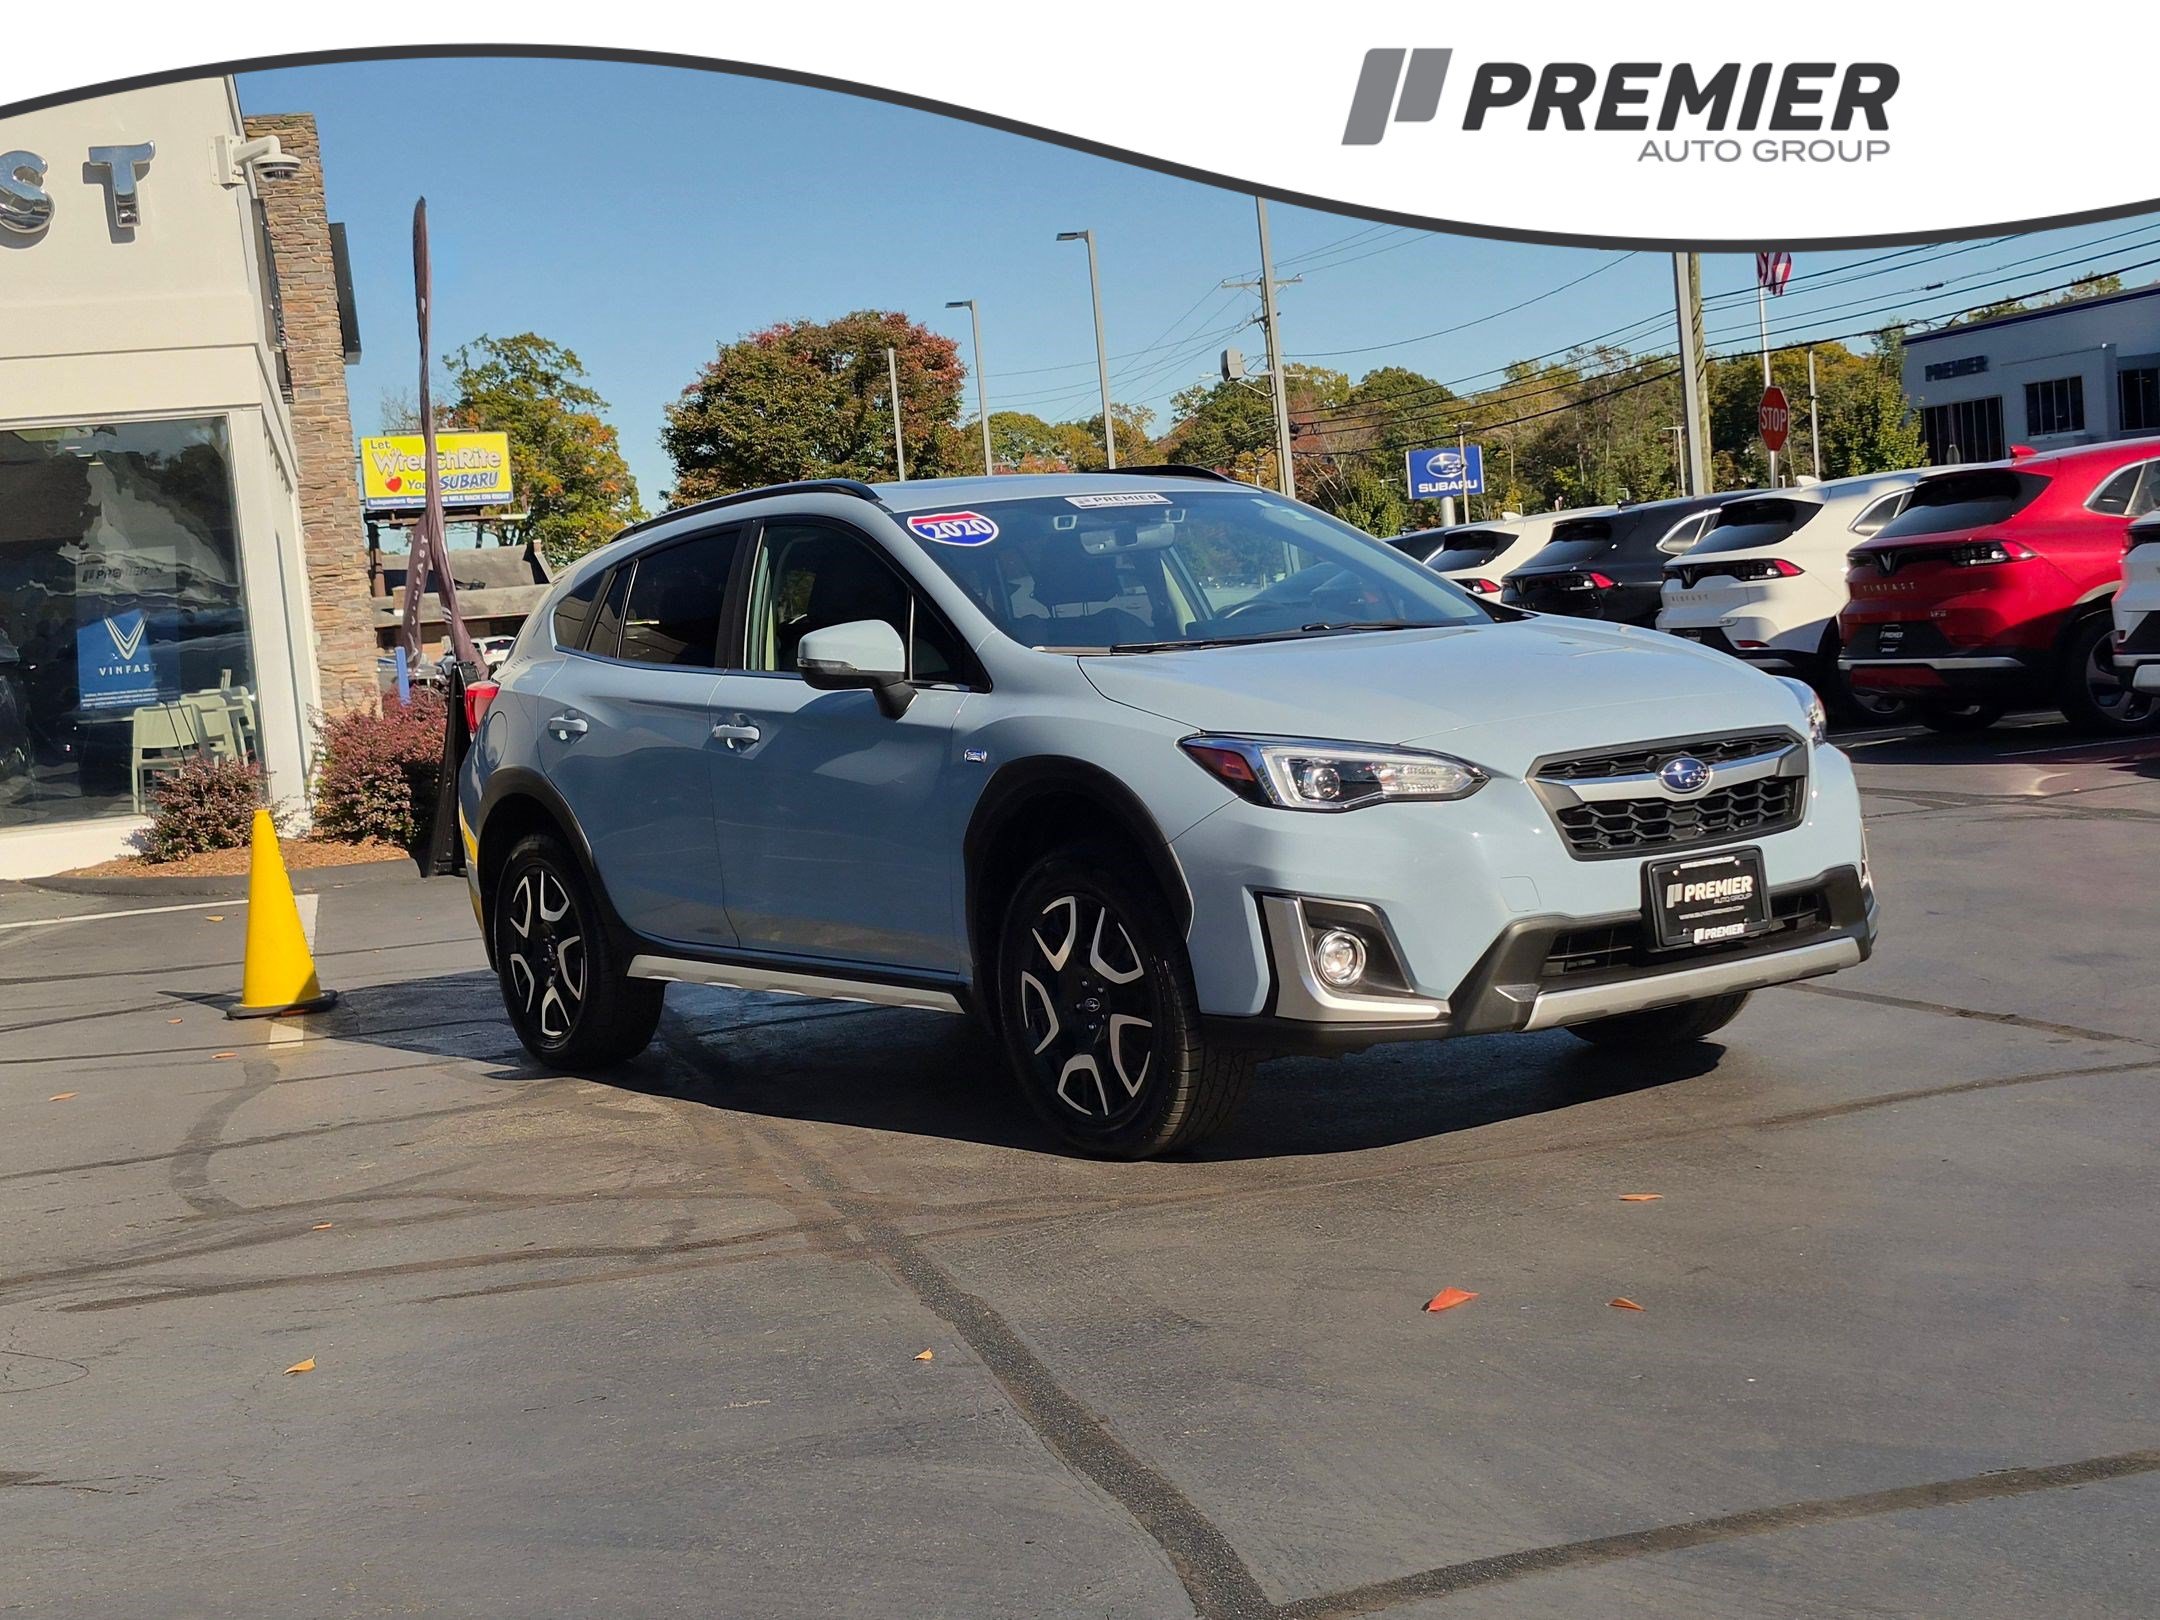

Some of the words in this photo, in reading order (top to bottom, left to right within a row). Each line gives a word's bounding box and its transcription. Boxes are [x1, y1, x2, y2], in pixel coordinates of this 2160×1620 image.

[1761, 406, 1787, 432] STOP
[370, 439, 391, 450] Let
[408, 479, 427, 490] You
[440, 471, 499, 491] SUBARU
[1092, 494, 1159, 503] PREMIER
[922, 518, 993, 540] 2020
[99, 663, 159, 677] VINFAST
[1684, 875, 1753, 903] PREMIER
[1704, 923, 1745, 939] PREMIER
